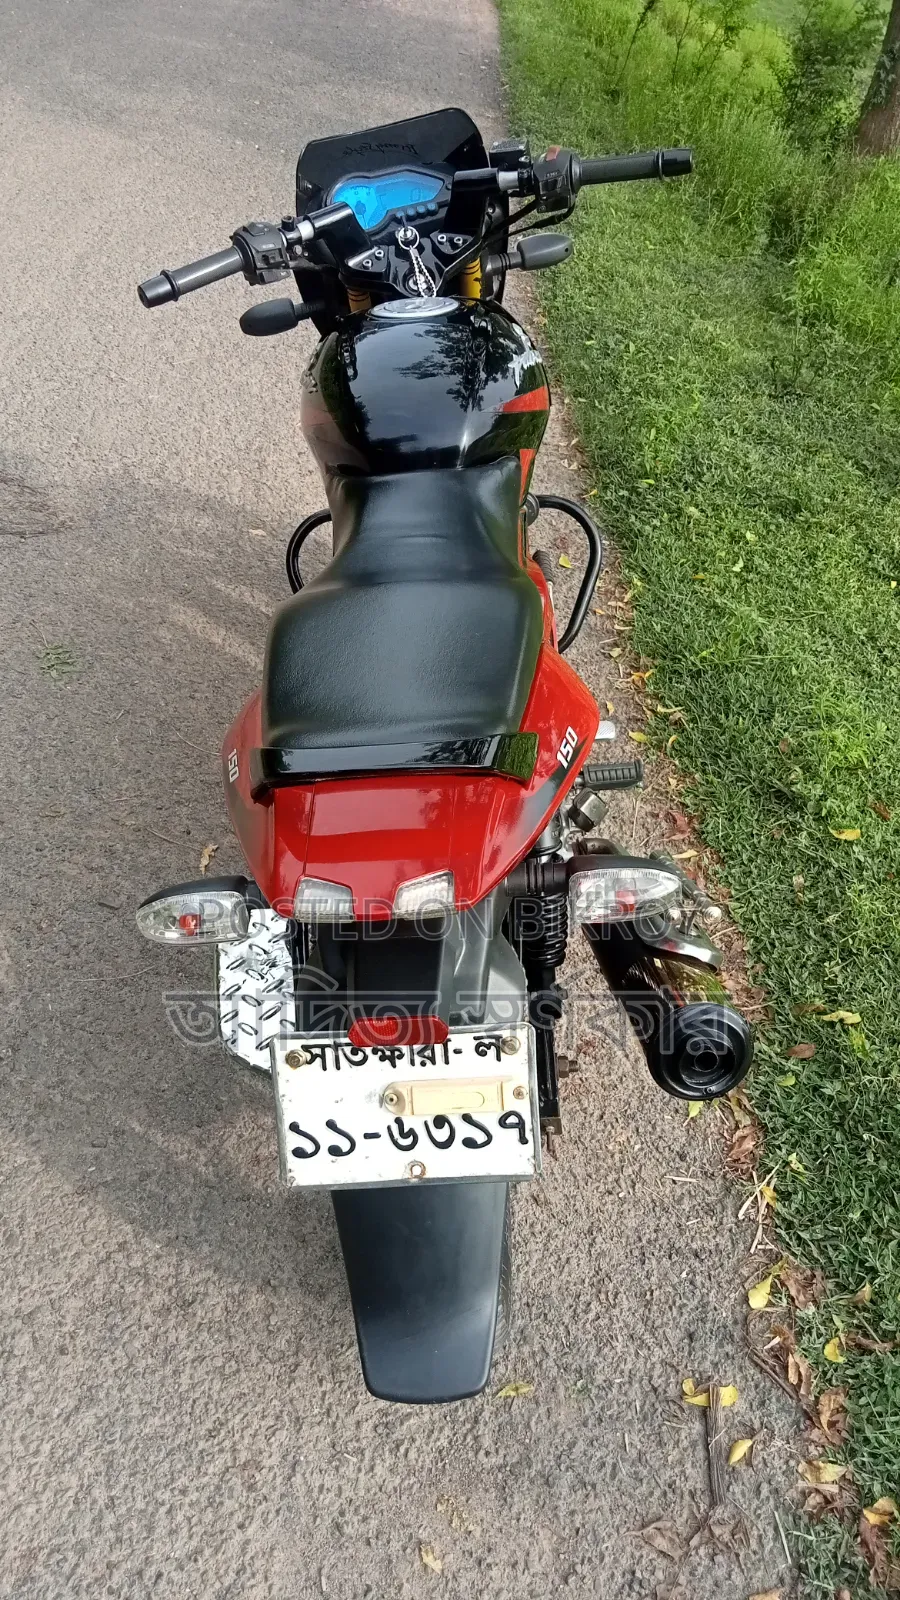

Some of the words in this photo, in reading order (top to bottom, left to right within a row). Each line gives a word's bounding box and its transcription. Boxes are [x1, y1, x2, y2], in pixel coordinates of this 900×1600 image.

[228, 748, 239, 783] 150
[556, 726, 578, 769] 150
[288, 1110, 529, 1159] ১১-৬৩১৭
